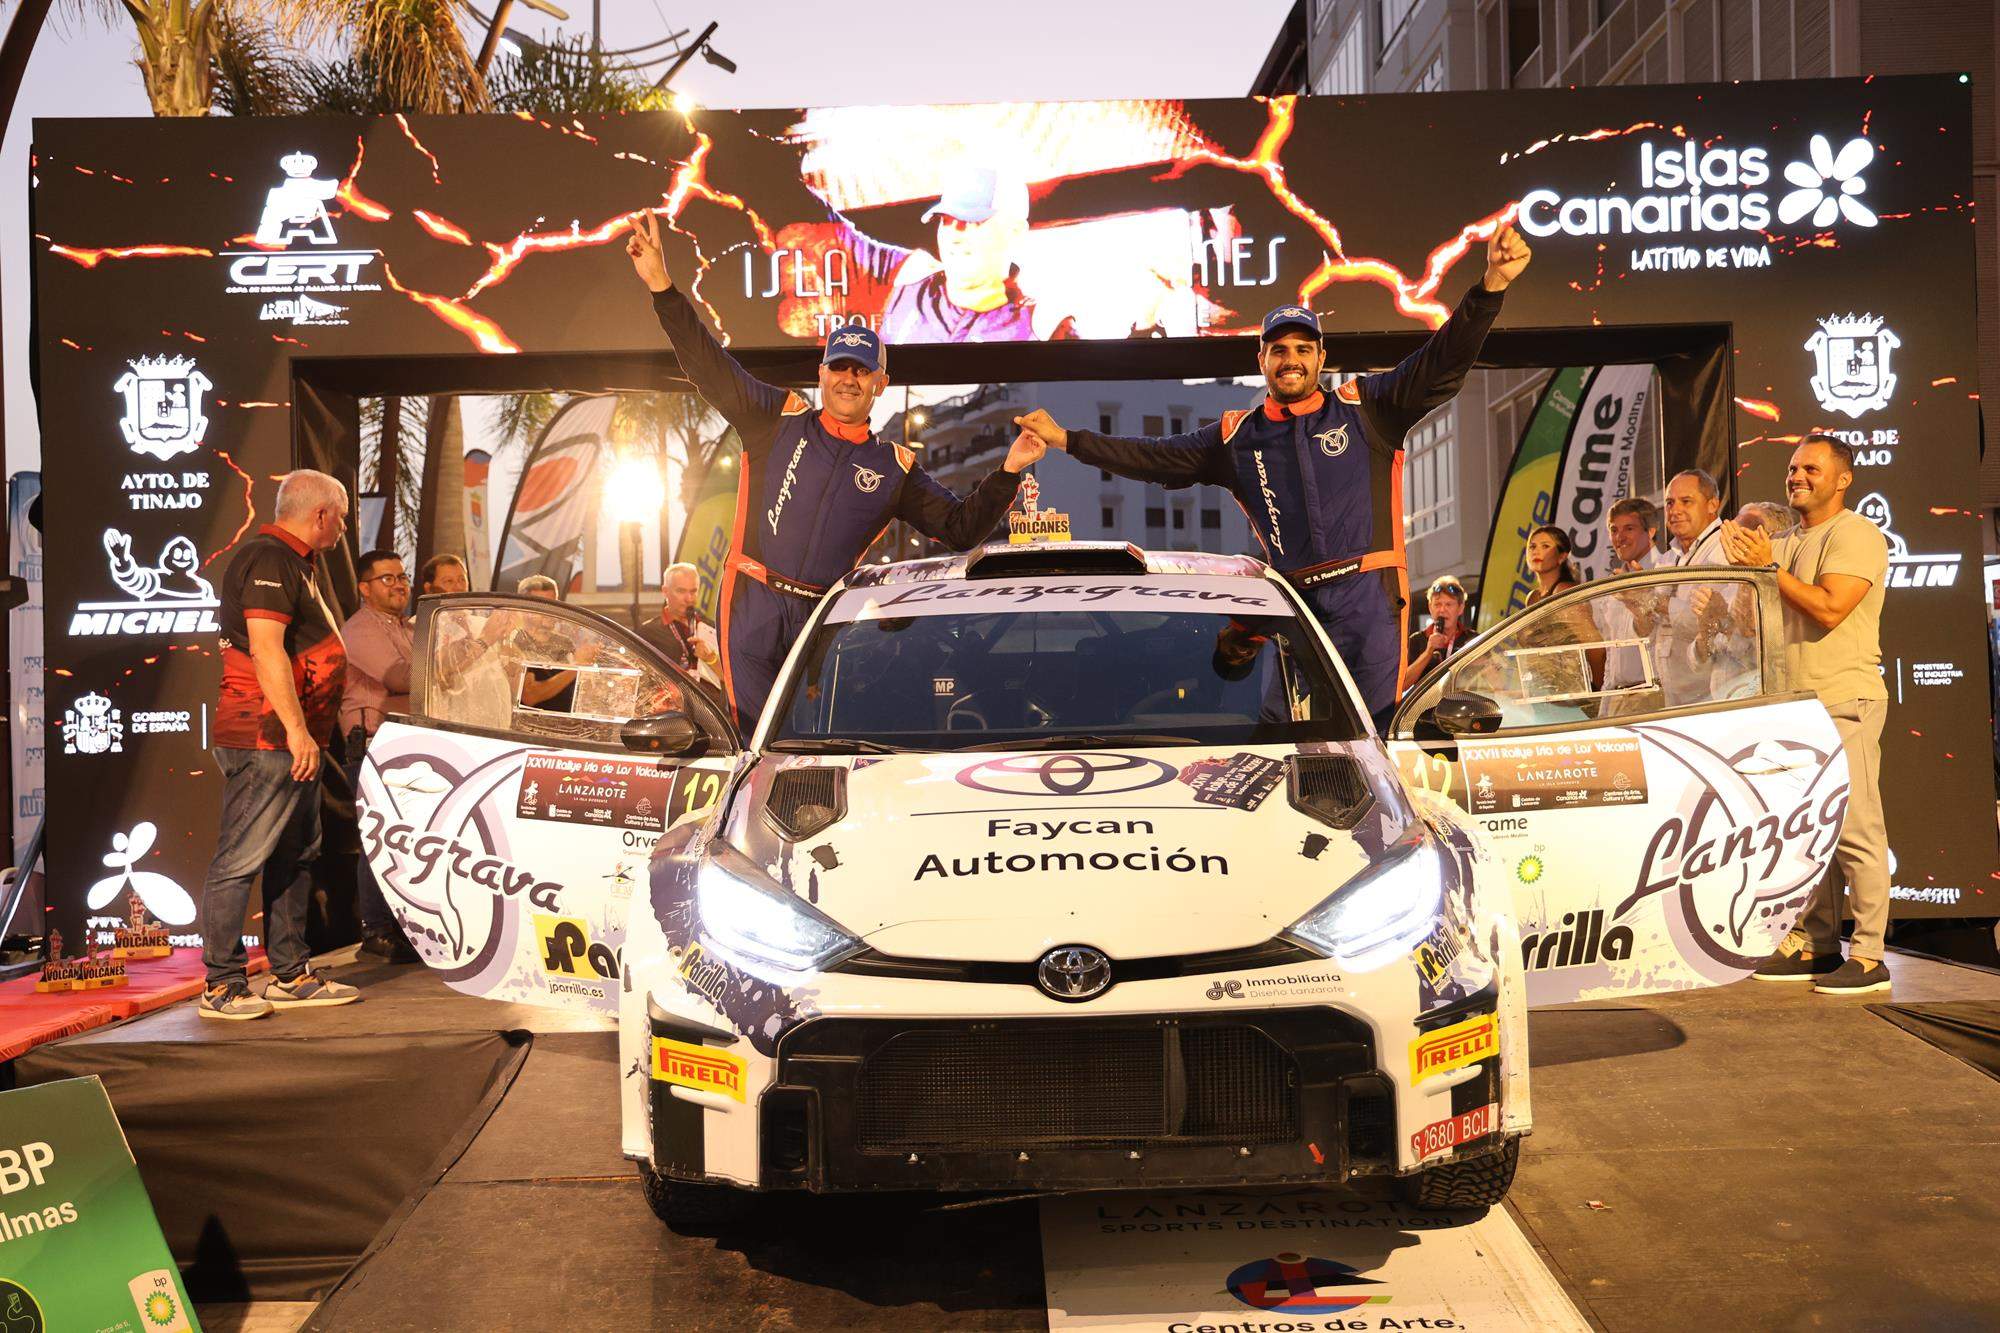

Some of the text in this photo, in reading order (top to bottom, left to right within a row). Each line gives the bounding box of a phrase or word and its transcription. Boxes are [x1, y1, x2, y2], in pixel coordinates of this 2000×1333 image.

[1640, 139, 1770, 190] Islas
[1518, 187, 1771, 237] Canarias
[1706, 247, 1728, 268] DE
[229, 254, 375, 286] CERT
[744, 248, 849, 299] ISLA
[1872, 429, 1899, 445] DE
[1852, 449, 1892, 466] AJO
[121, 472, 210, 490] AYTO. DE
[767, 437, 808, 536] Lanzagrava
[1572, 393, 1623, 582] came
[129, 492, 203, 510] TINAJO
[1253, 449, 1285, 556] Lanzagrava
[1010, 520, 1069, 535] VOLCANES
[878, 582, 1268, 608] Lanzagrava
[68, 610, 222, 637] MICHEL
[935, 681, 955, 693] MP
[132, 711, 191, 723] GOBIERNO
[132, 722, 148, 734] DE
[1557, 744, 1572, 755] de
[526, 756, 556, 769] XXVII
[556, 759, 582, 774] Rallye
[601, 763, 614, 774] de
[635, 765, 675, 780] Volcanes
[1517, 767, 1599, 783] LANZAROTE
[558, 783, 628, 800] LANZAROTE
[683, 772, 721, 814] 12
[988, 818, 1154, 841] Faycan
[913, 846, 1229, 881] Automoción
[115, 935, 170, 949] VOLCANES
[83, 964, 126, 980] VOLCANES
[682, 947, 728, 1002] Parrilla
[1246, 973, 1341, 987] Inmobiliaria
[549, 980, 604, 999] jparrilla.es
[1250, 986, 1345, 999] Diseño Lanzarote
[1416, 1022, 1493, 1074] PIRELLI
[659, 1046, 739, 1091] PIRELLI
[1424, 1121, 1456, 1154] 2680
[1463, 1107, 1489, 1140] BCL
[1101, 1216, 1454, 1234] SPORTS DESTINATION
[153, 1276, 167, 1288] bp
[1167, 1316, 1467, 1333] Centros de Arte,
